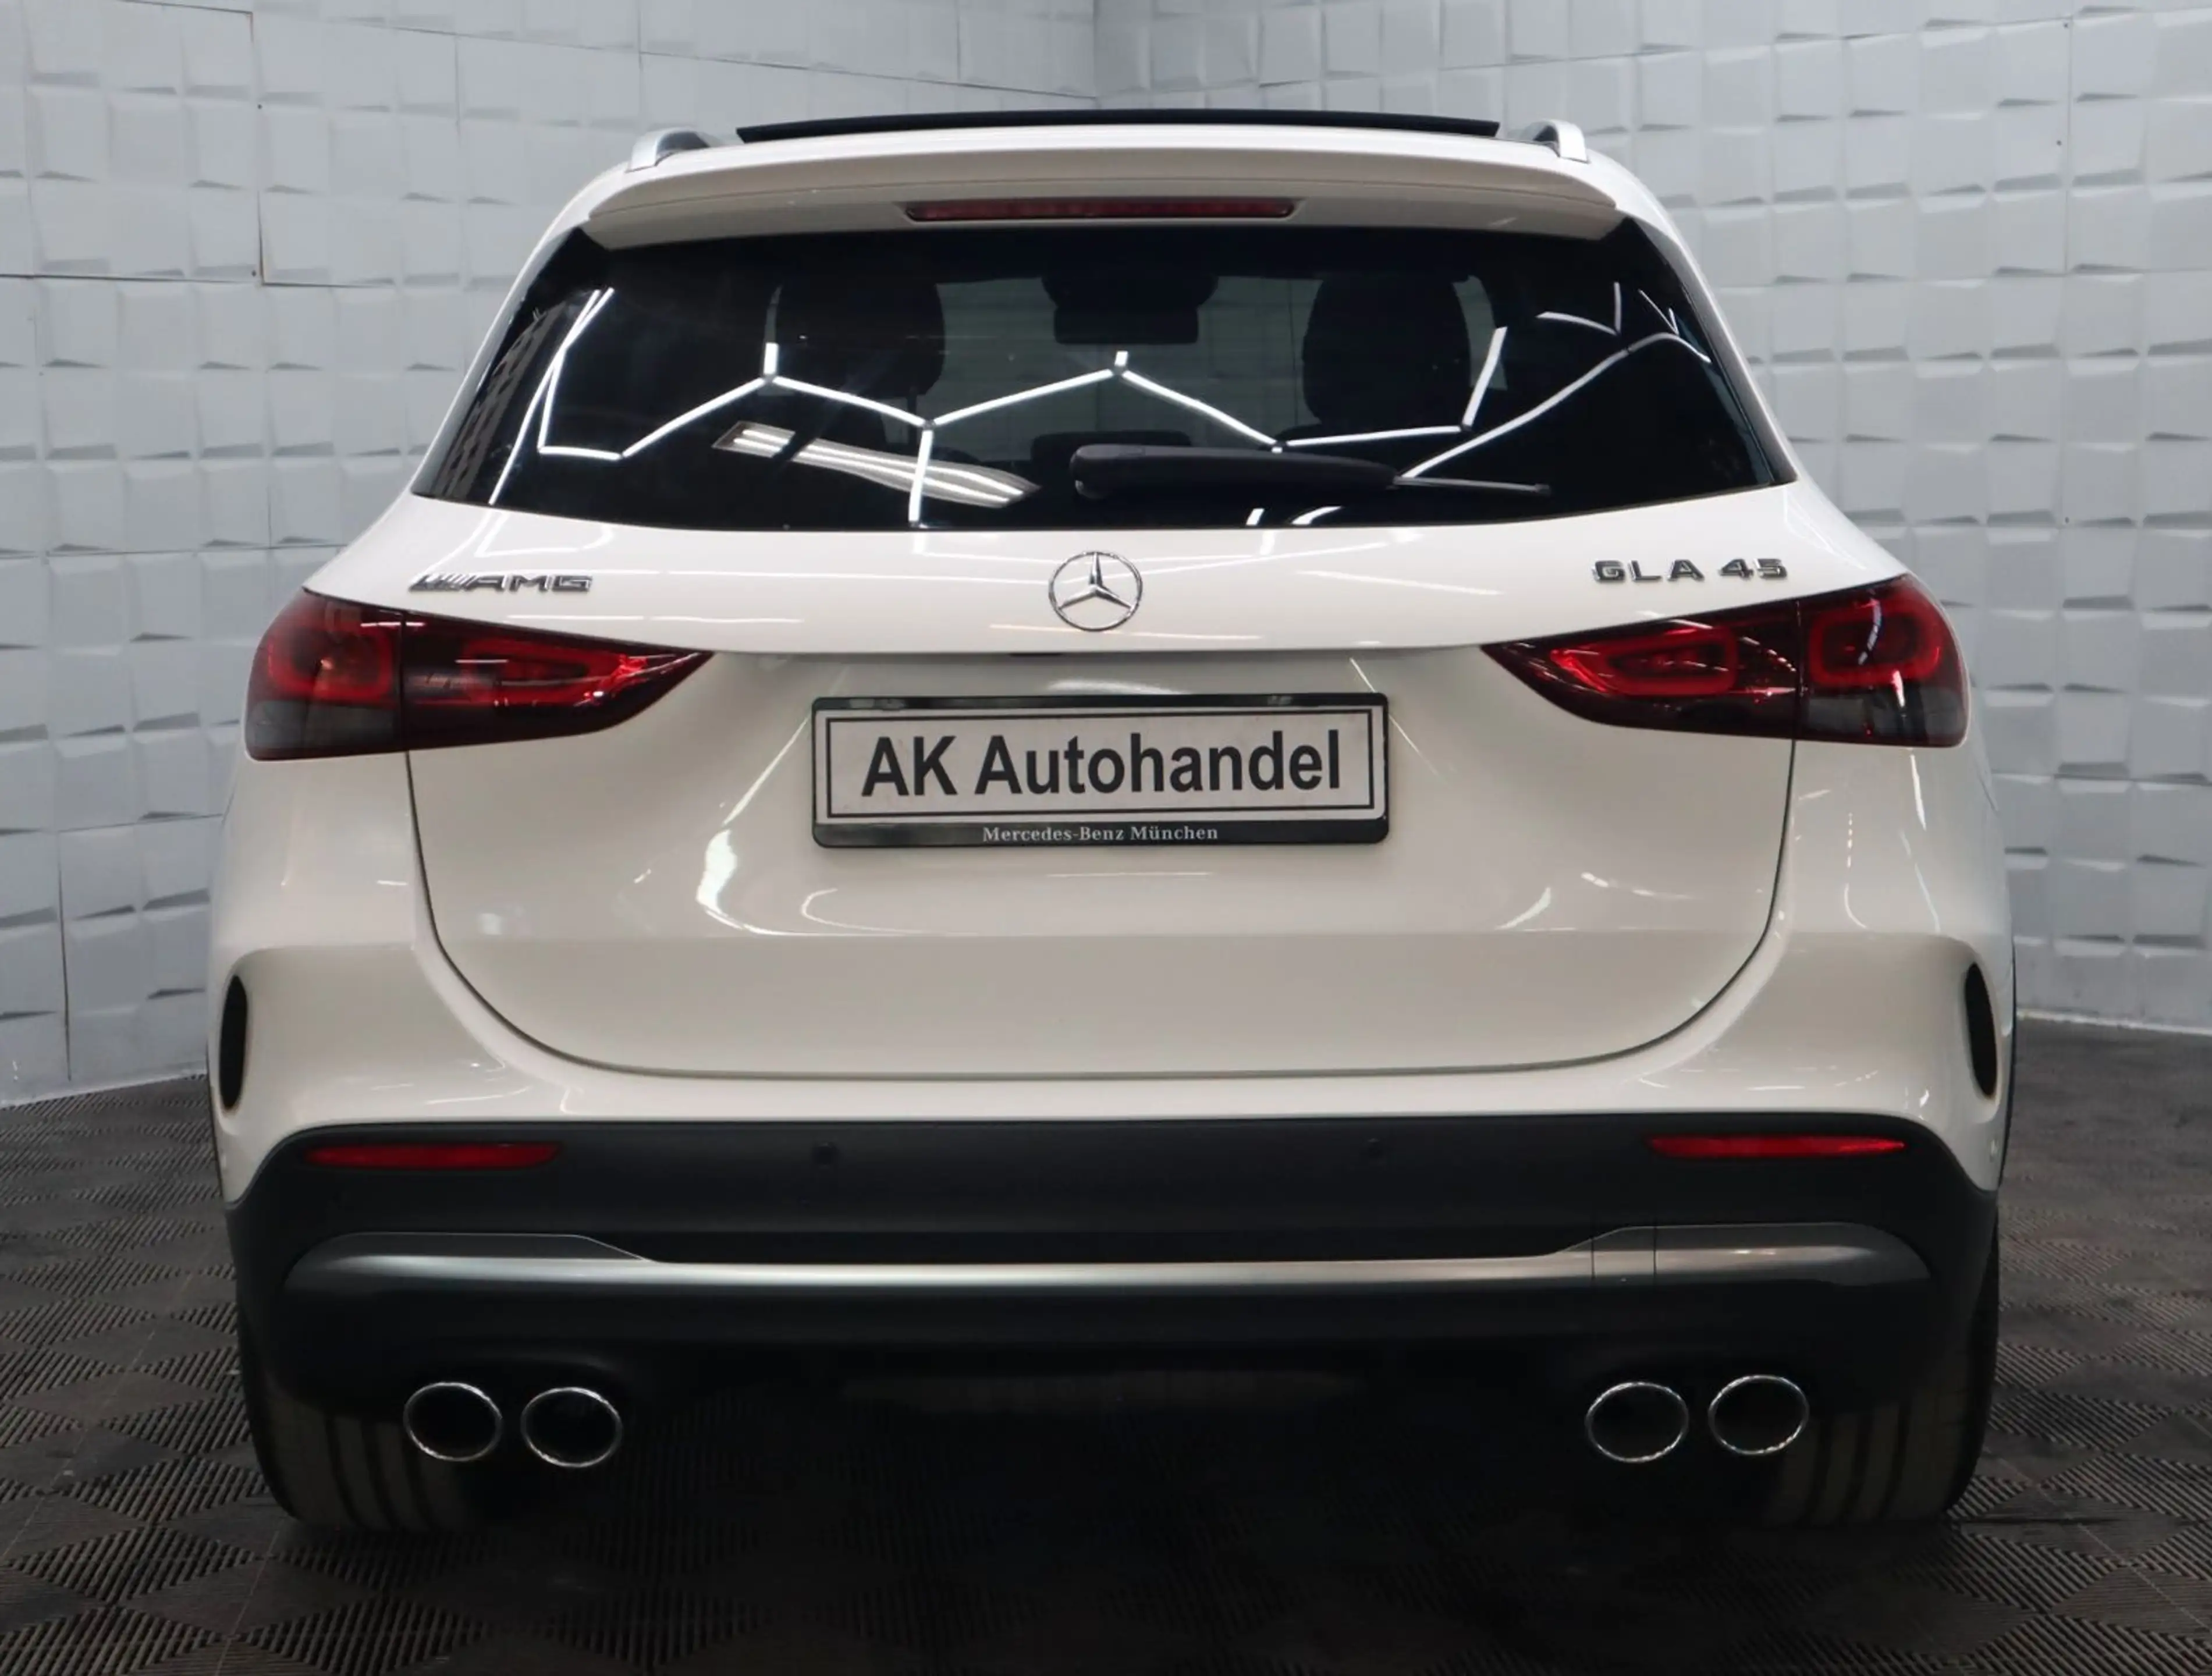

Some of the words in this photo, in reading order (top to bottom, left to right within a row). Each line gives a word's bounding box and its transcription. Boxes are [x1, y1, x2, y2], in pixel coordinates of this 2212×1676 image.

[1592, 559, 1705, 582] GLA
[1717, 558, 1788, 580] 45
[460, 574, 592, 592] AMG
[862, 735, 958, 797] AK
[974, 729, 1340, 796] Autohandel
[983, 826, 1124, 842] Mercedes-Benz
[1130, 825, 1218, 840] München
